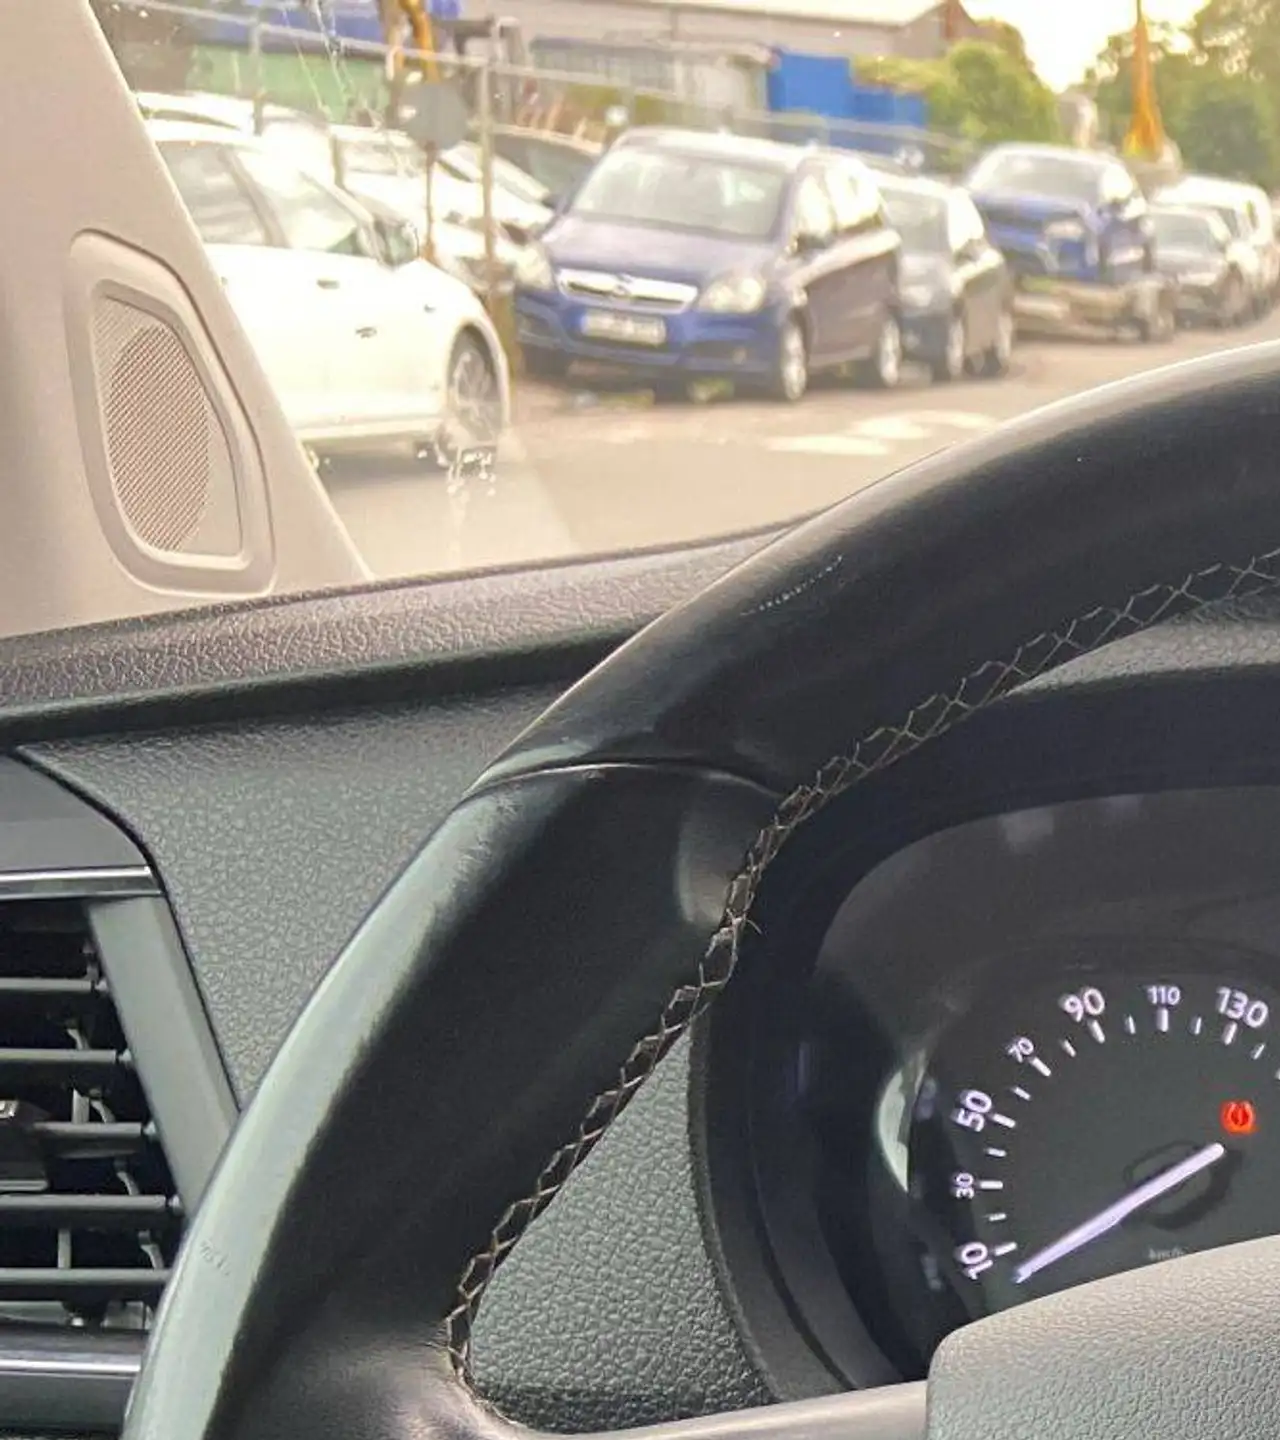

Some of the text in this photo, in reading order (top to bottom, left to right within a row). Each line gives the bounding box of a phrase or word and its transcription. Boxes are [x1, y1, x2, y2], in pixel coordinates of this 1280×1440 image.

[1061, 987, 1106, 1023] 90
[1147, 985, 1182, 1006] 110
[1216, 984, 1269, 1029] 130
[1008, 1036, 1034, 1062] 70
[956, 1089, 993, 1132] 50
[954, 1172, 976, 1200] 30
[960, 1241, 993, 1280] 10
